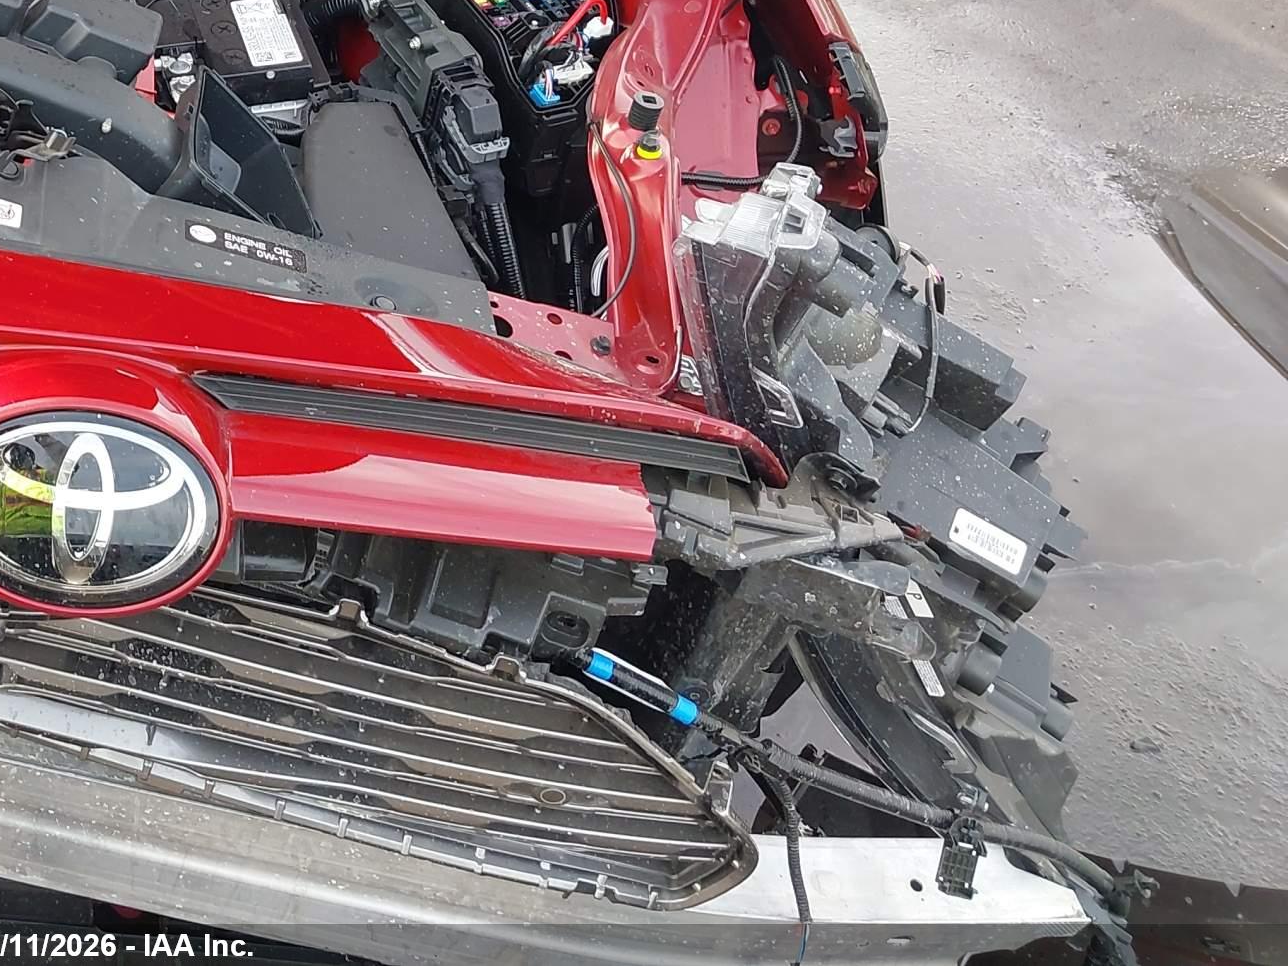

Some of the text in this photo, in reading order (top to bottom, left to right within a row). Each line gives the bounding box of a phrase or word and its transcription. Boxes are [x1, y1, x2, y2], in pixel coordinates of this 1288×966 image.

[224, 232, 293, 258] ENGINE OIL
[224, 240, 293, 266] SAE 0W-16
